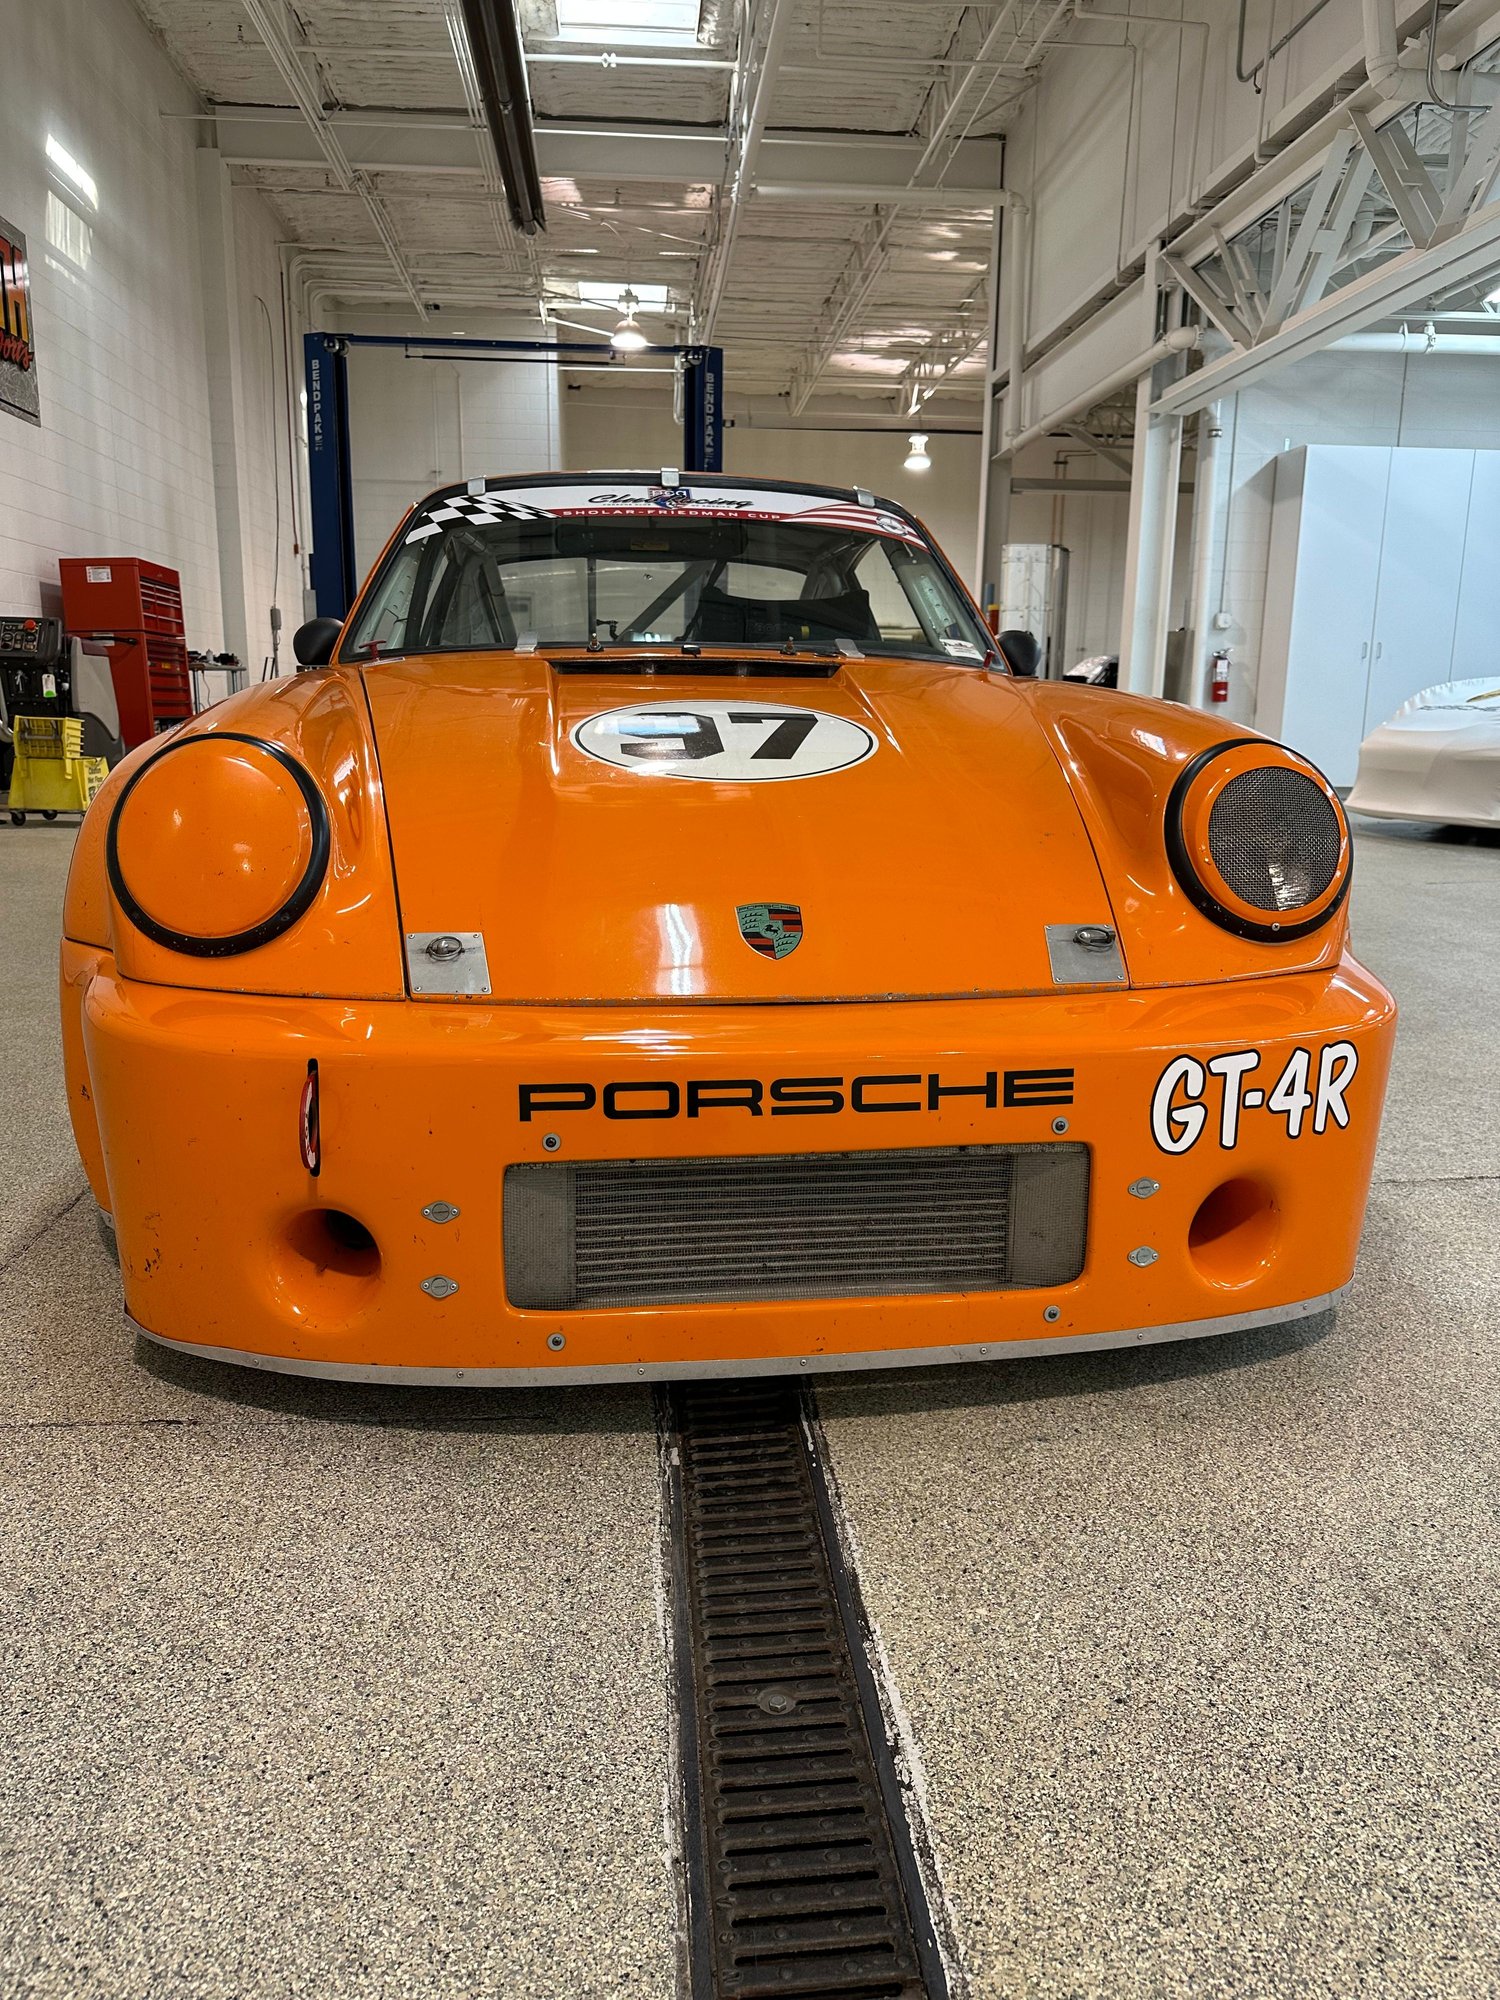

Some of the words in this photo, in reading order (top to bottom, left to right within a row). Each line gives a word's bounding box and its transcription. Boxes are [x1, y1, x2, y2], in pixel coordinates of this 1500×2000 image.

[311, 359, 323, 434] BENDPAK
[704, 372, 715, 447] BENDPAK
[562, 509, 739, 517] SHOLAR-FRIEDMAN
[747, 512, 781, 520] CUP
[617, 711, 819, 760] 97
[518, 1068, 1075, 1122] PORSCHE
[1151, 1040, 1359, 1155] GT-4R
